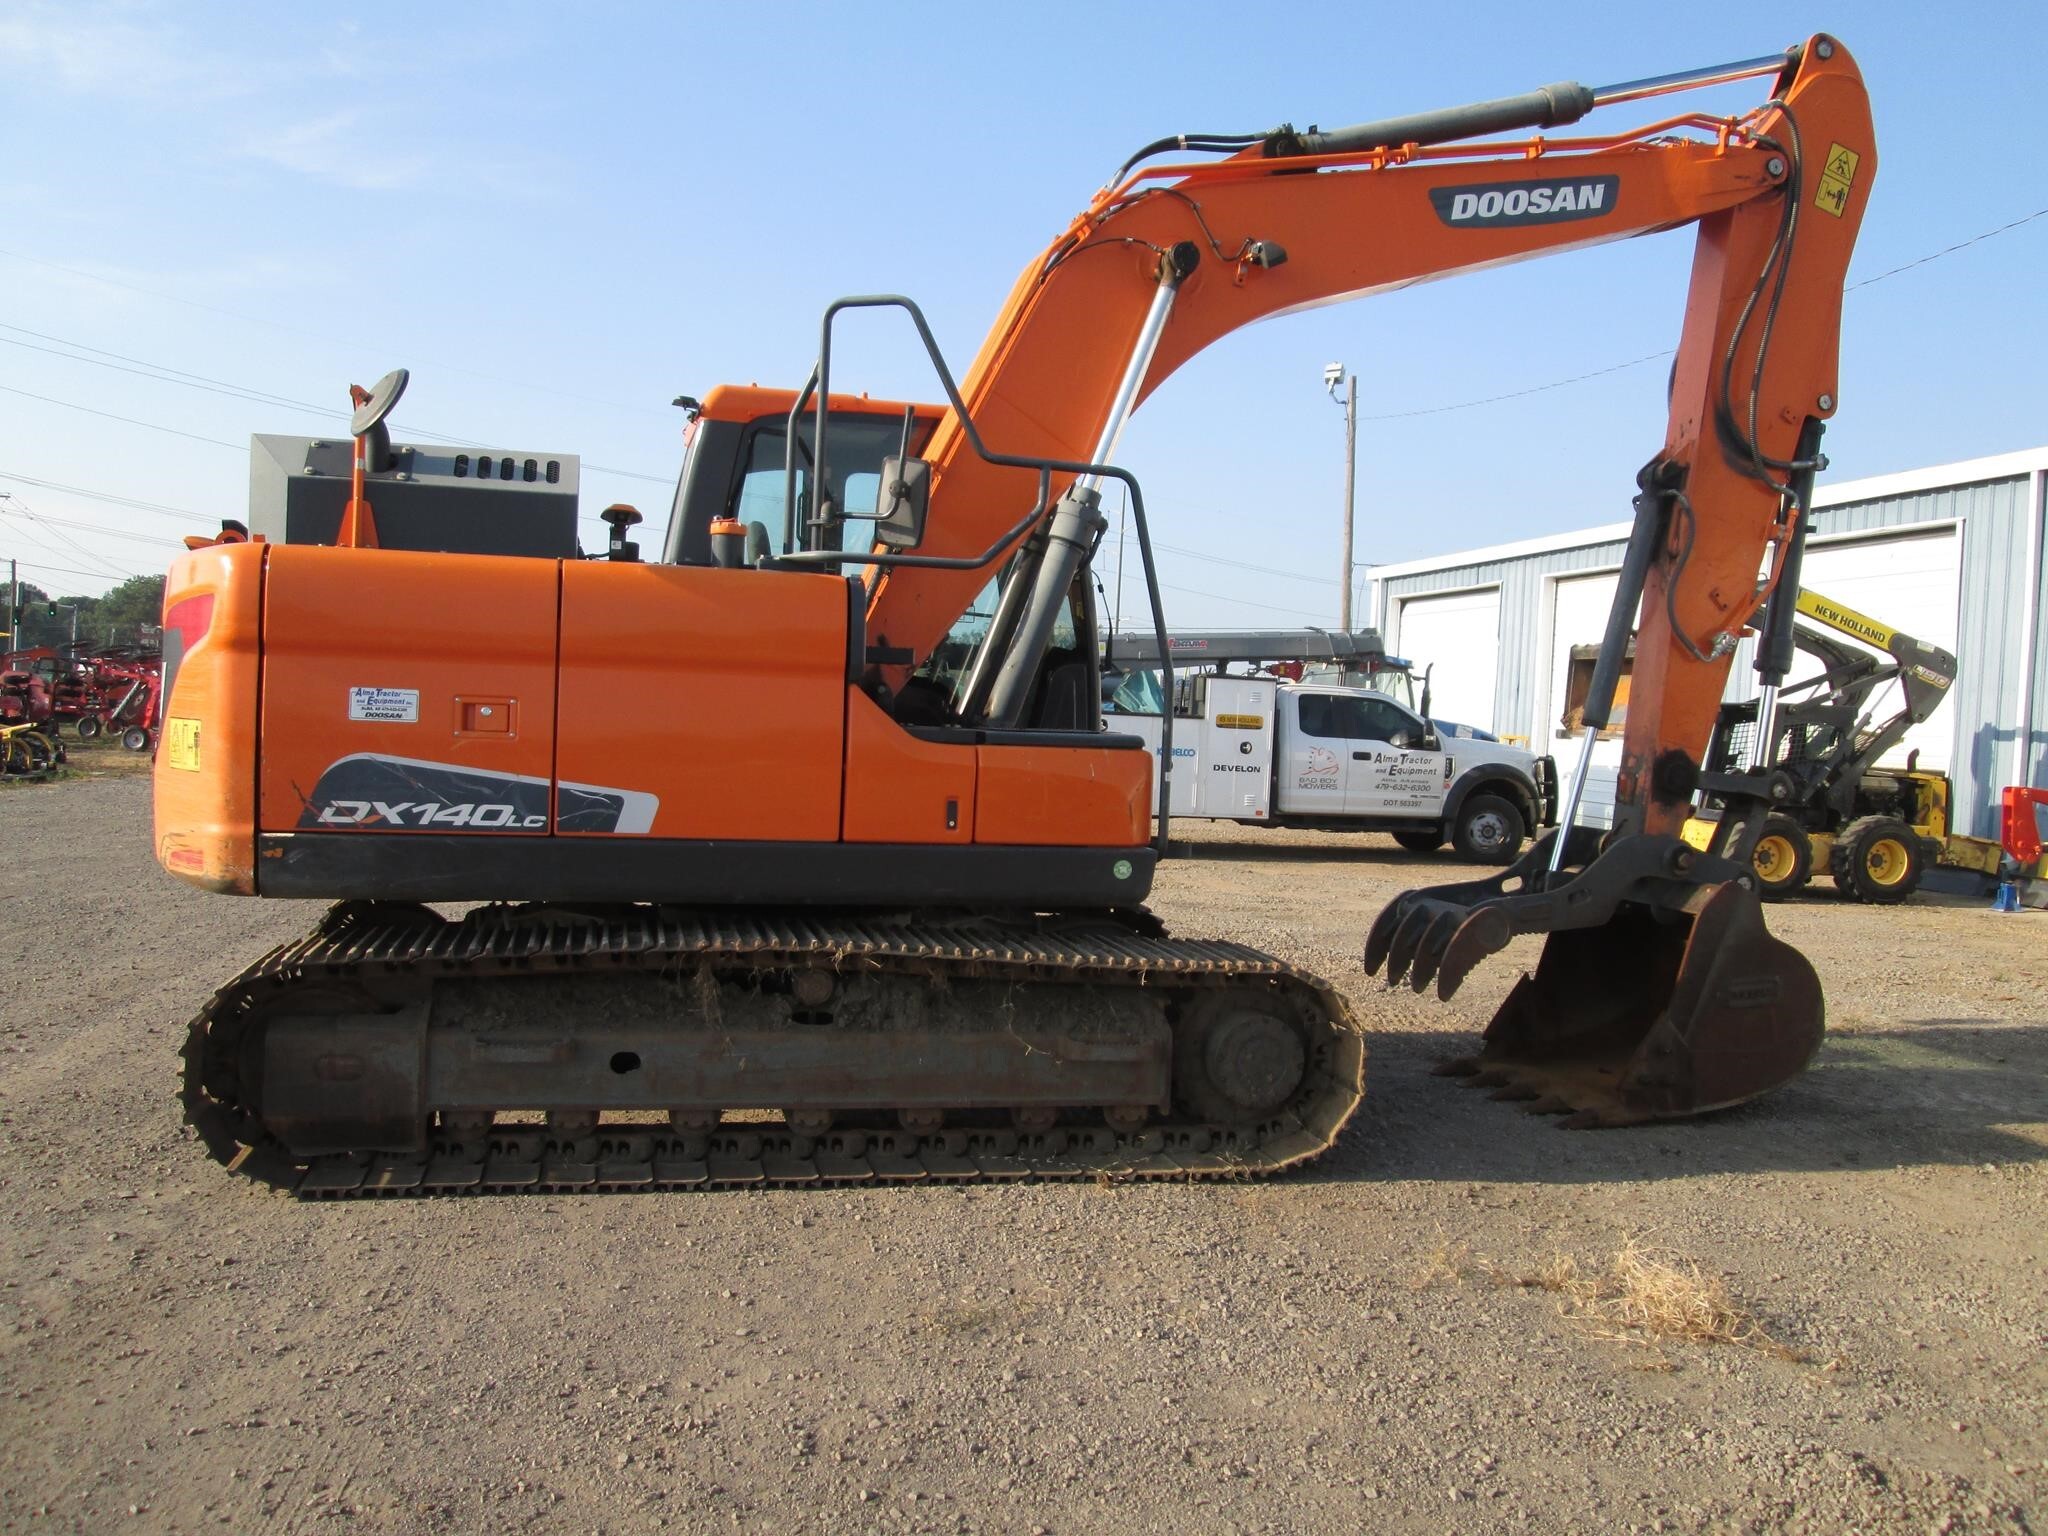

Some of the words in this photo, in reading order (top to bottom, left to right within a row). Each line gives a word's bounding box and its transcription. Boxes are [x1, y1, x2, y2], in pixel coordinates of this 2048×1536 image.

[1451, 184, 1605, 220] DOOSAN
[1815, 604, 1839, 621] NEW
[1839, 615, 1886, 643] HOLLAND
[355, 688, 375, 697] Alma
[375, 688, 402, 697] Tractor
[367, 696, 405, 706] Equipment
[1374, 752, 1398, 764] Alma
[1400, 754, 1433, 765] Tractor
[1213, 764, 1261, 773] DEVELON
[1389, 764, 1438, 776] Equipment
